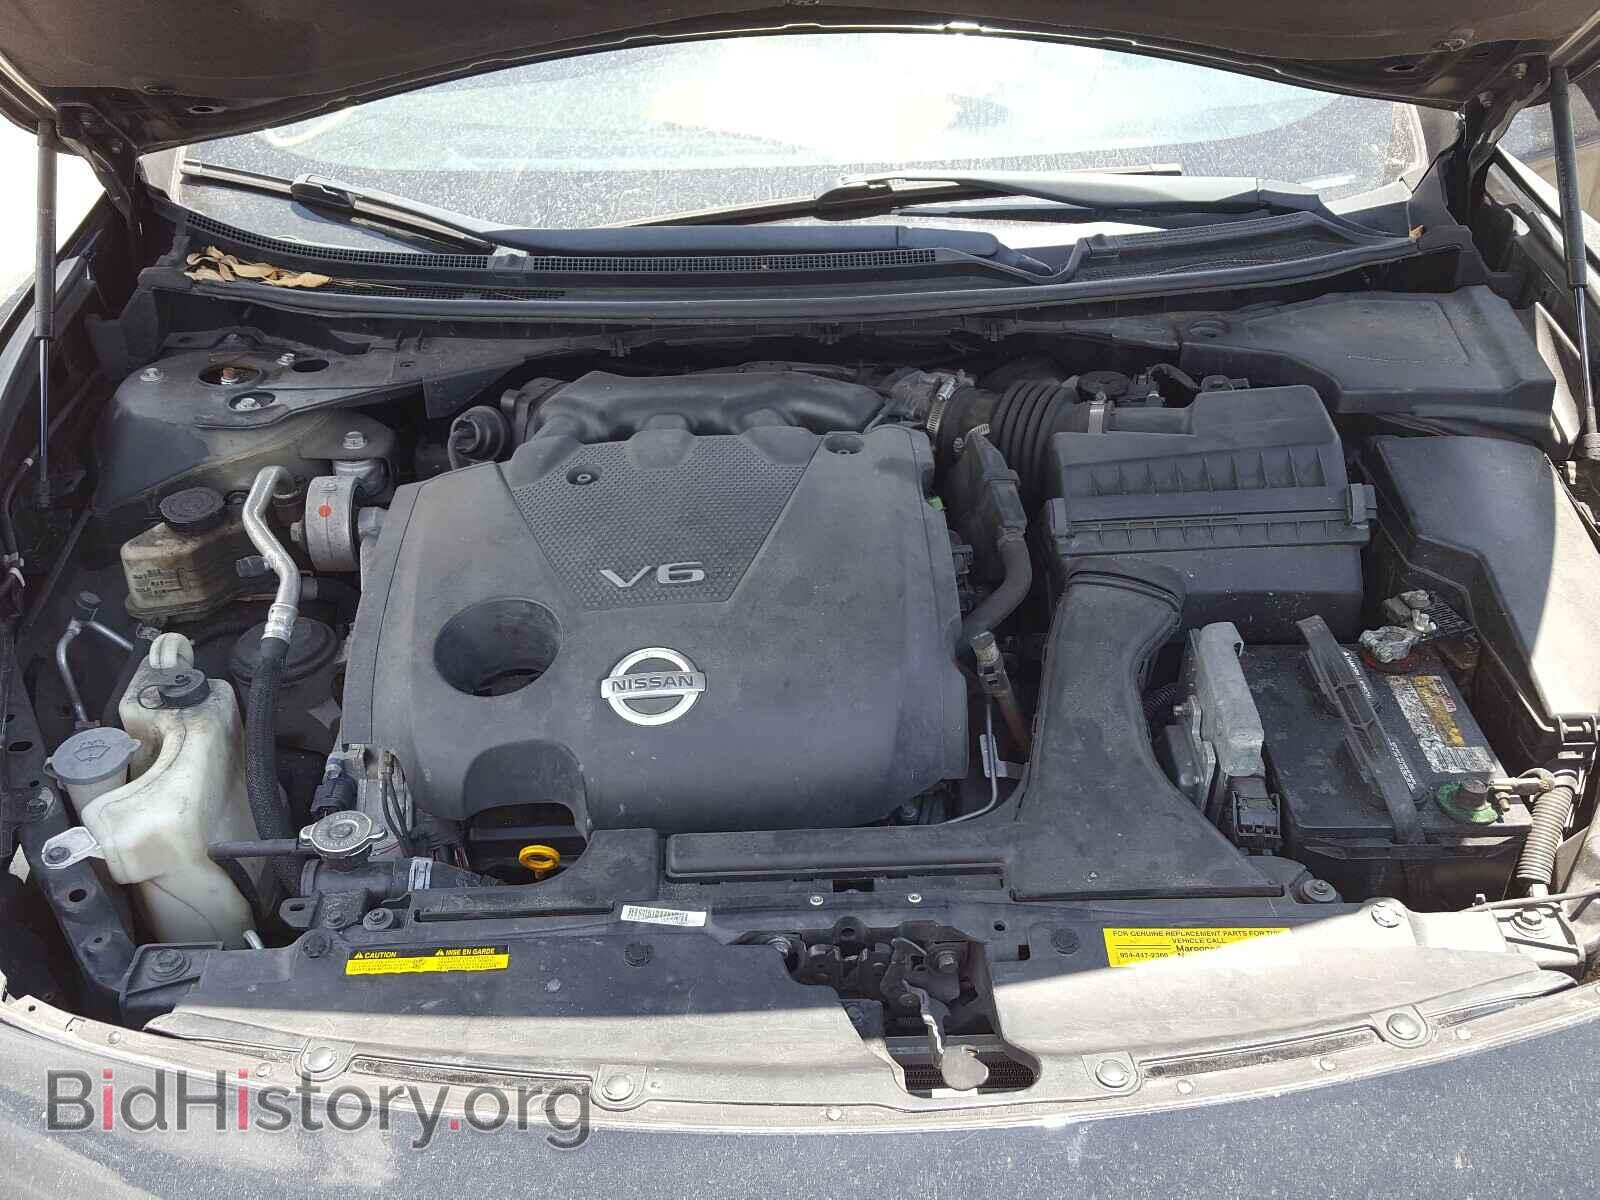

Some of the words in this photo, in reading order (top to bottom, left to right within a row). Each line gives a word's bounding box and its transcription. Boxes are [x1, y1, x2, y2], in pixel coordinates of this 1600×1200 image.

[600, 561, 705, 588] V6
[612, 674, 694, 692] NISSAN
[364, 951, 397, 959] CAUTION
[472, 947, 496, 955] GARDE
